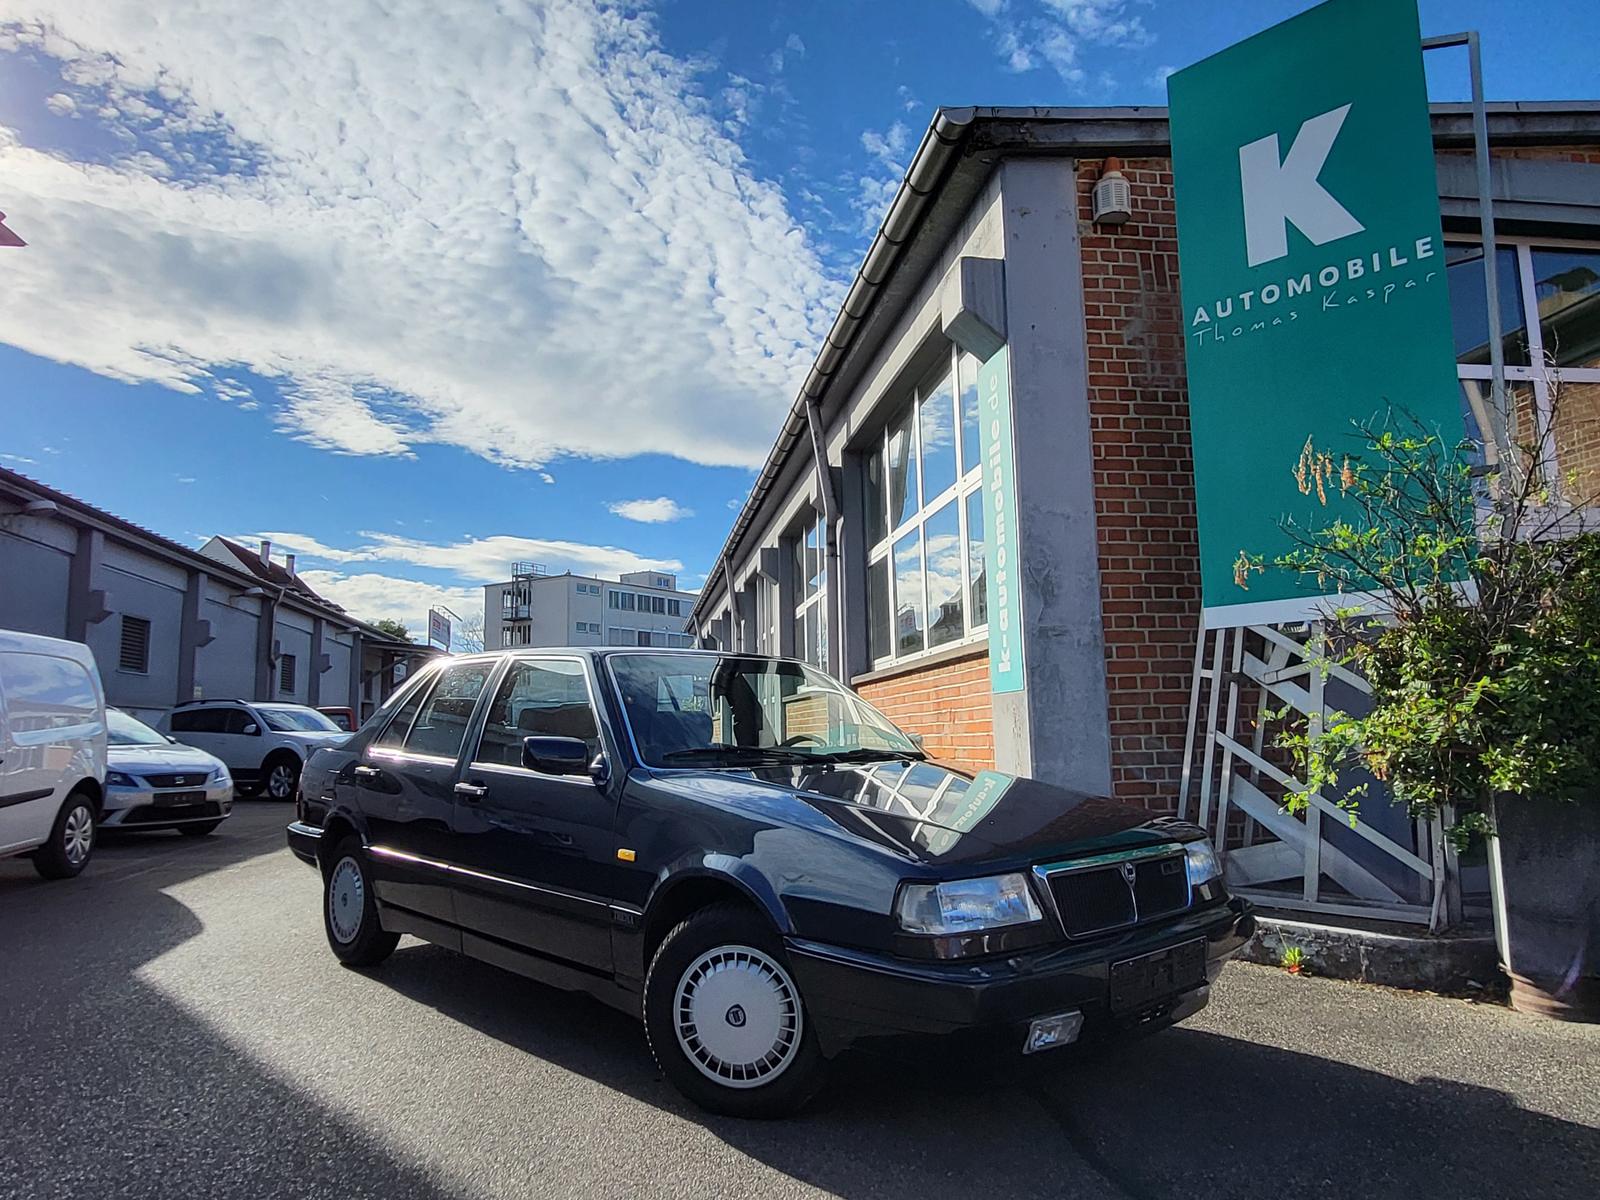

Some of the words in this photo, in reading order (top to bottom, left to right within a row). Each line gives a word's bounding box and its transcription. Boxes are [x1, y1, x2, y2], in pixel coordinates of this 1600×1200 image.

[1239, 103, 1366, 268] K
[1192, 236, 1434, 326] AUTOMOBILE
[1193, 310, 1298, 346] Thomas
[1322, 272, 1437, 311] Kaspar
